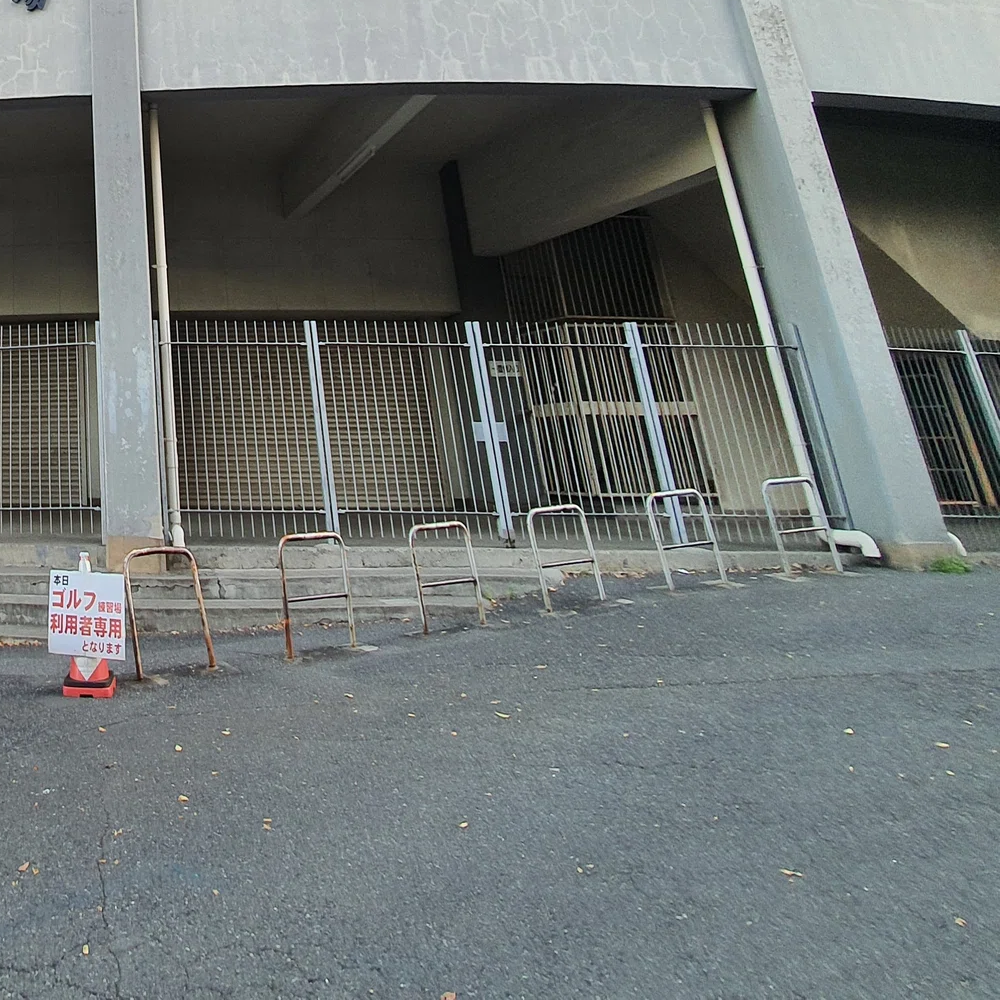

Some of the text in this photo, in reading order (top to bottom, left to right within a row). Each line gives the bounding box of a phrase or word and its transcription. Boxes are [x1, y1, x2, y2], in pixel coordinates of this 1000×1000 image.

[53, 574, 69, 586] 本日
[52, 587, 122, 615] ゴルフ練習場
[50, 613, 122, 639] 利用者専用
[82, 640, 122, 655] となります
